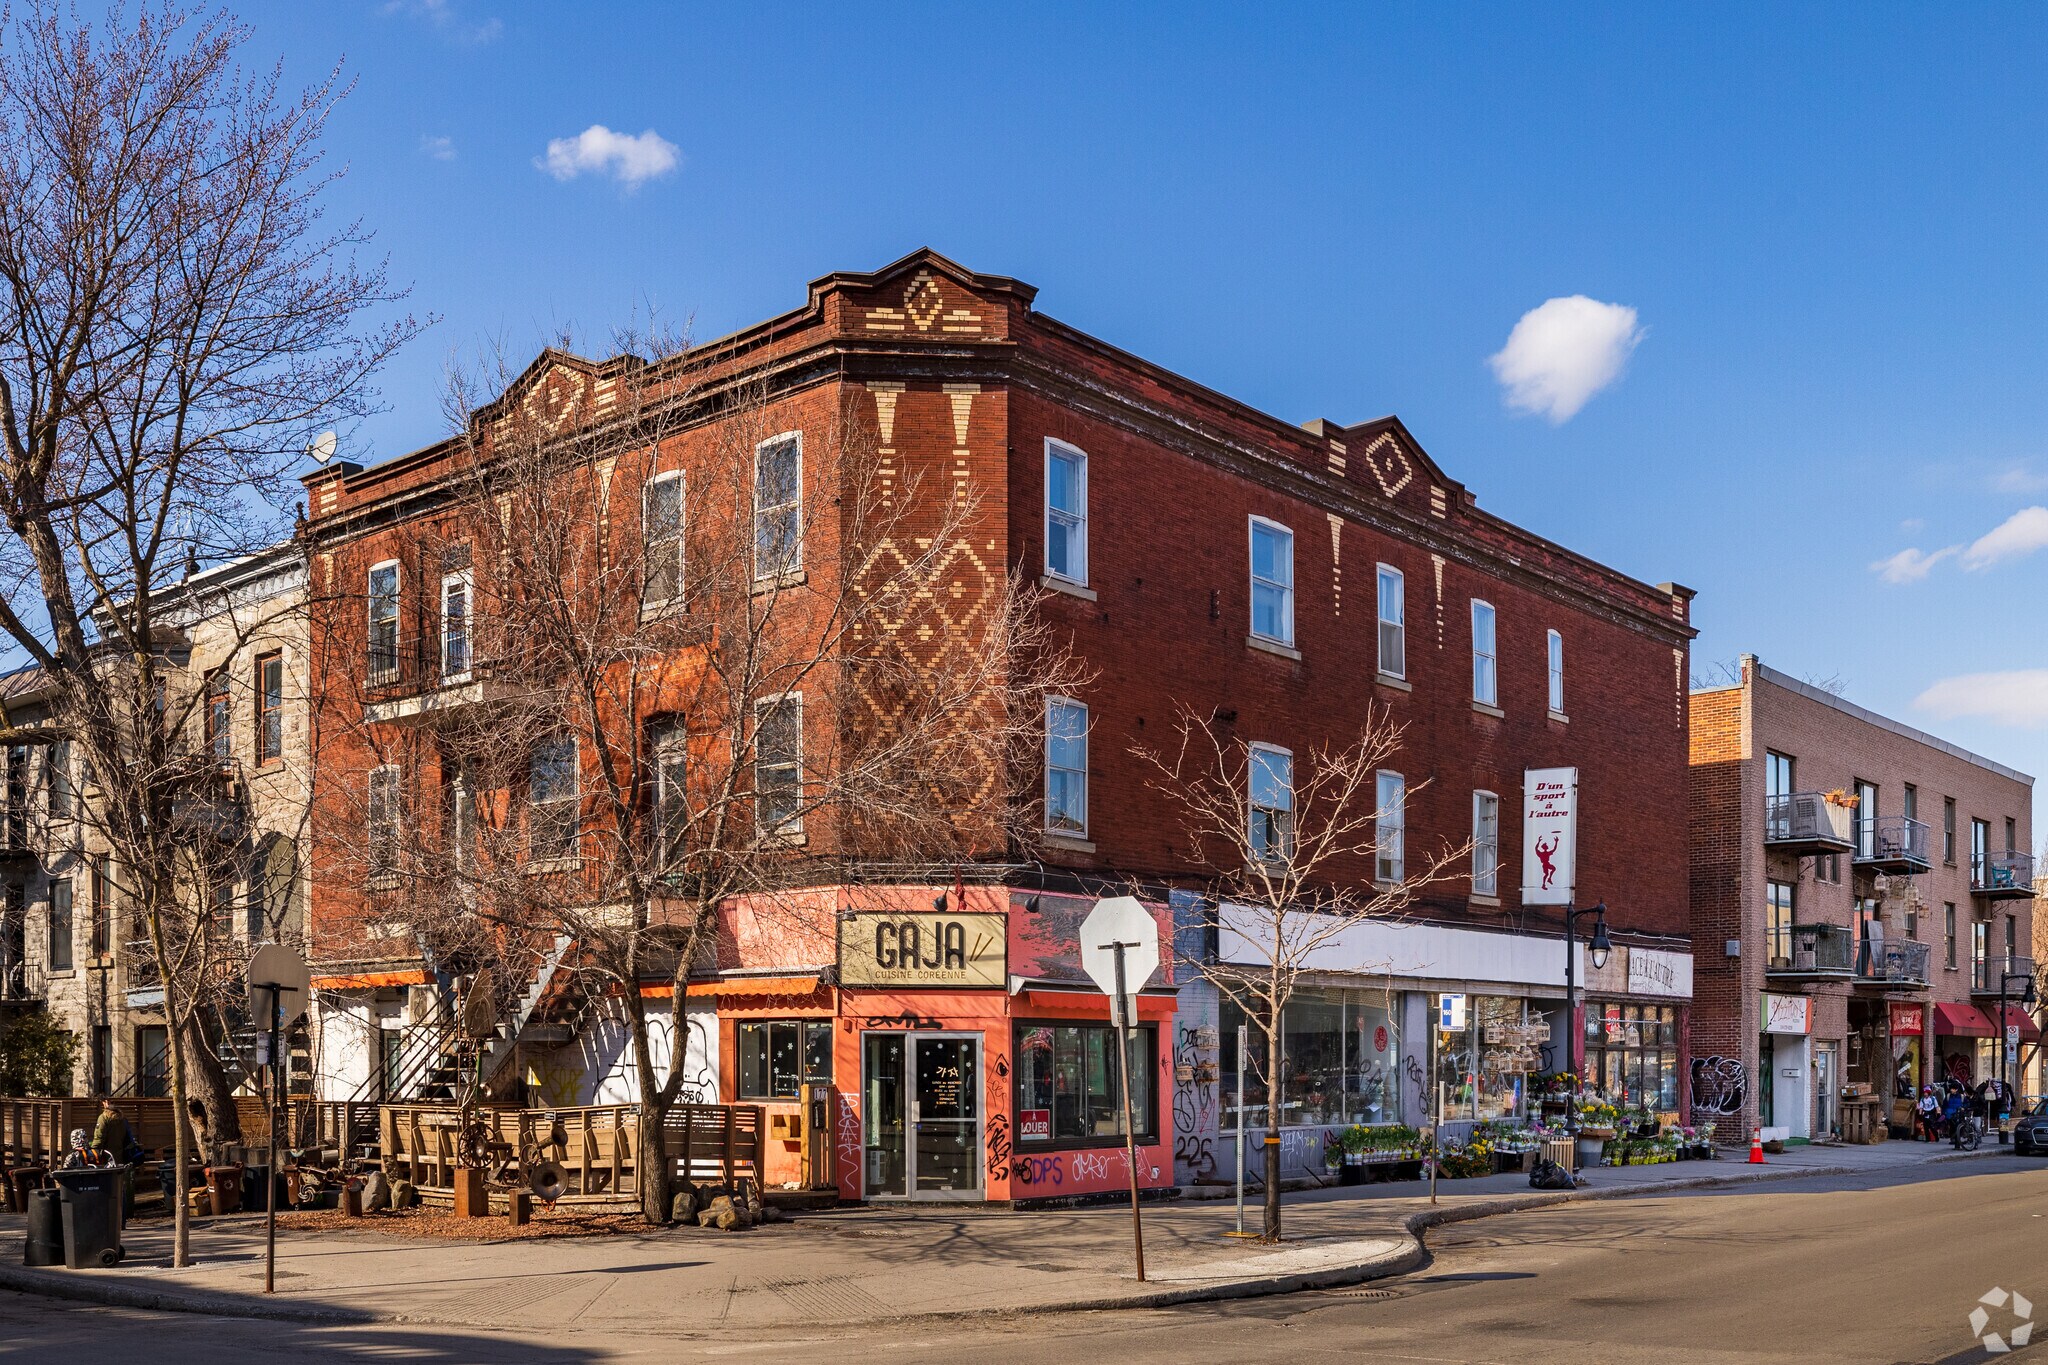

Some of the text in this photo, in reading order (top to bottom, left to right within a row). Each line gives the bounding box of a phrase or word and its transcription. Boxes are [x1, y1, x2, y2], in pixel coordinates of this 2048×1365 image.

[1533, 792, 1566, 801] sport
[1528, 810, 1568, 818] l'autre
[876, 921, 966, 970] GAJA
[875, 970, 912, 979] CUISINE
[1021, 1121, 1048, 1133] LOUER
[1033, 1157, 1063, 1184] DPS
